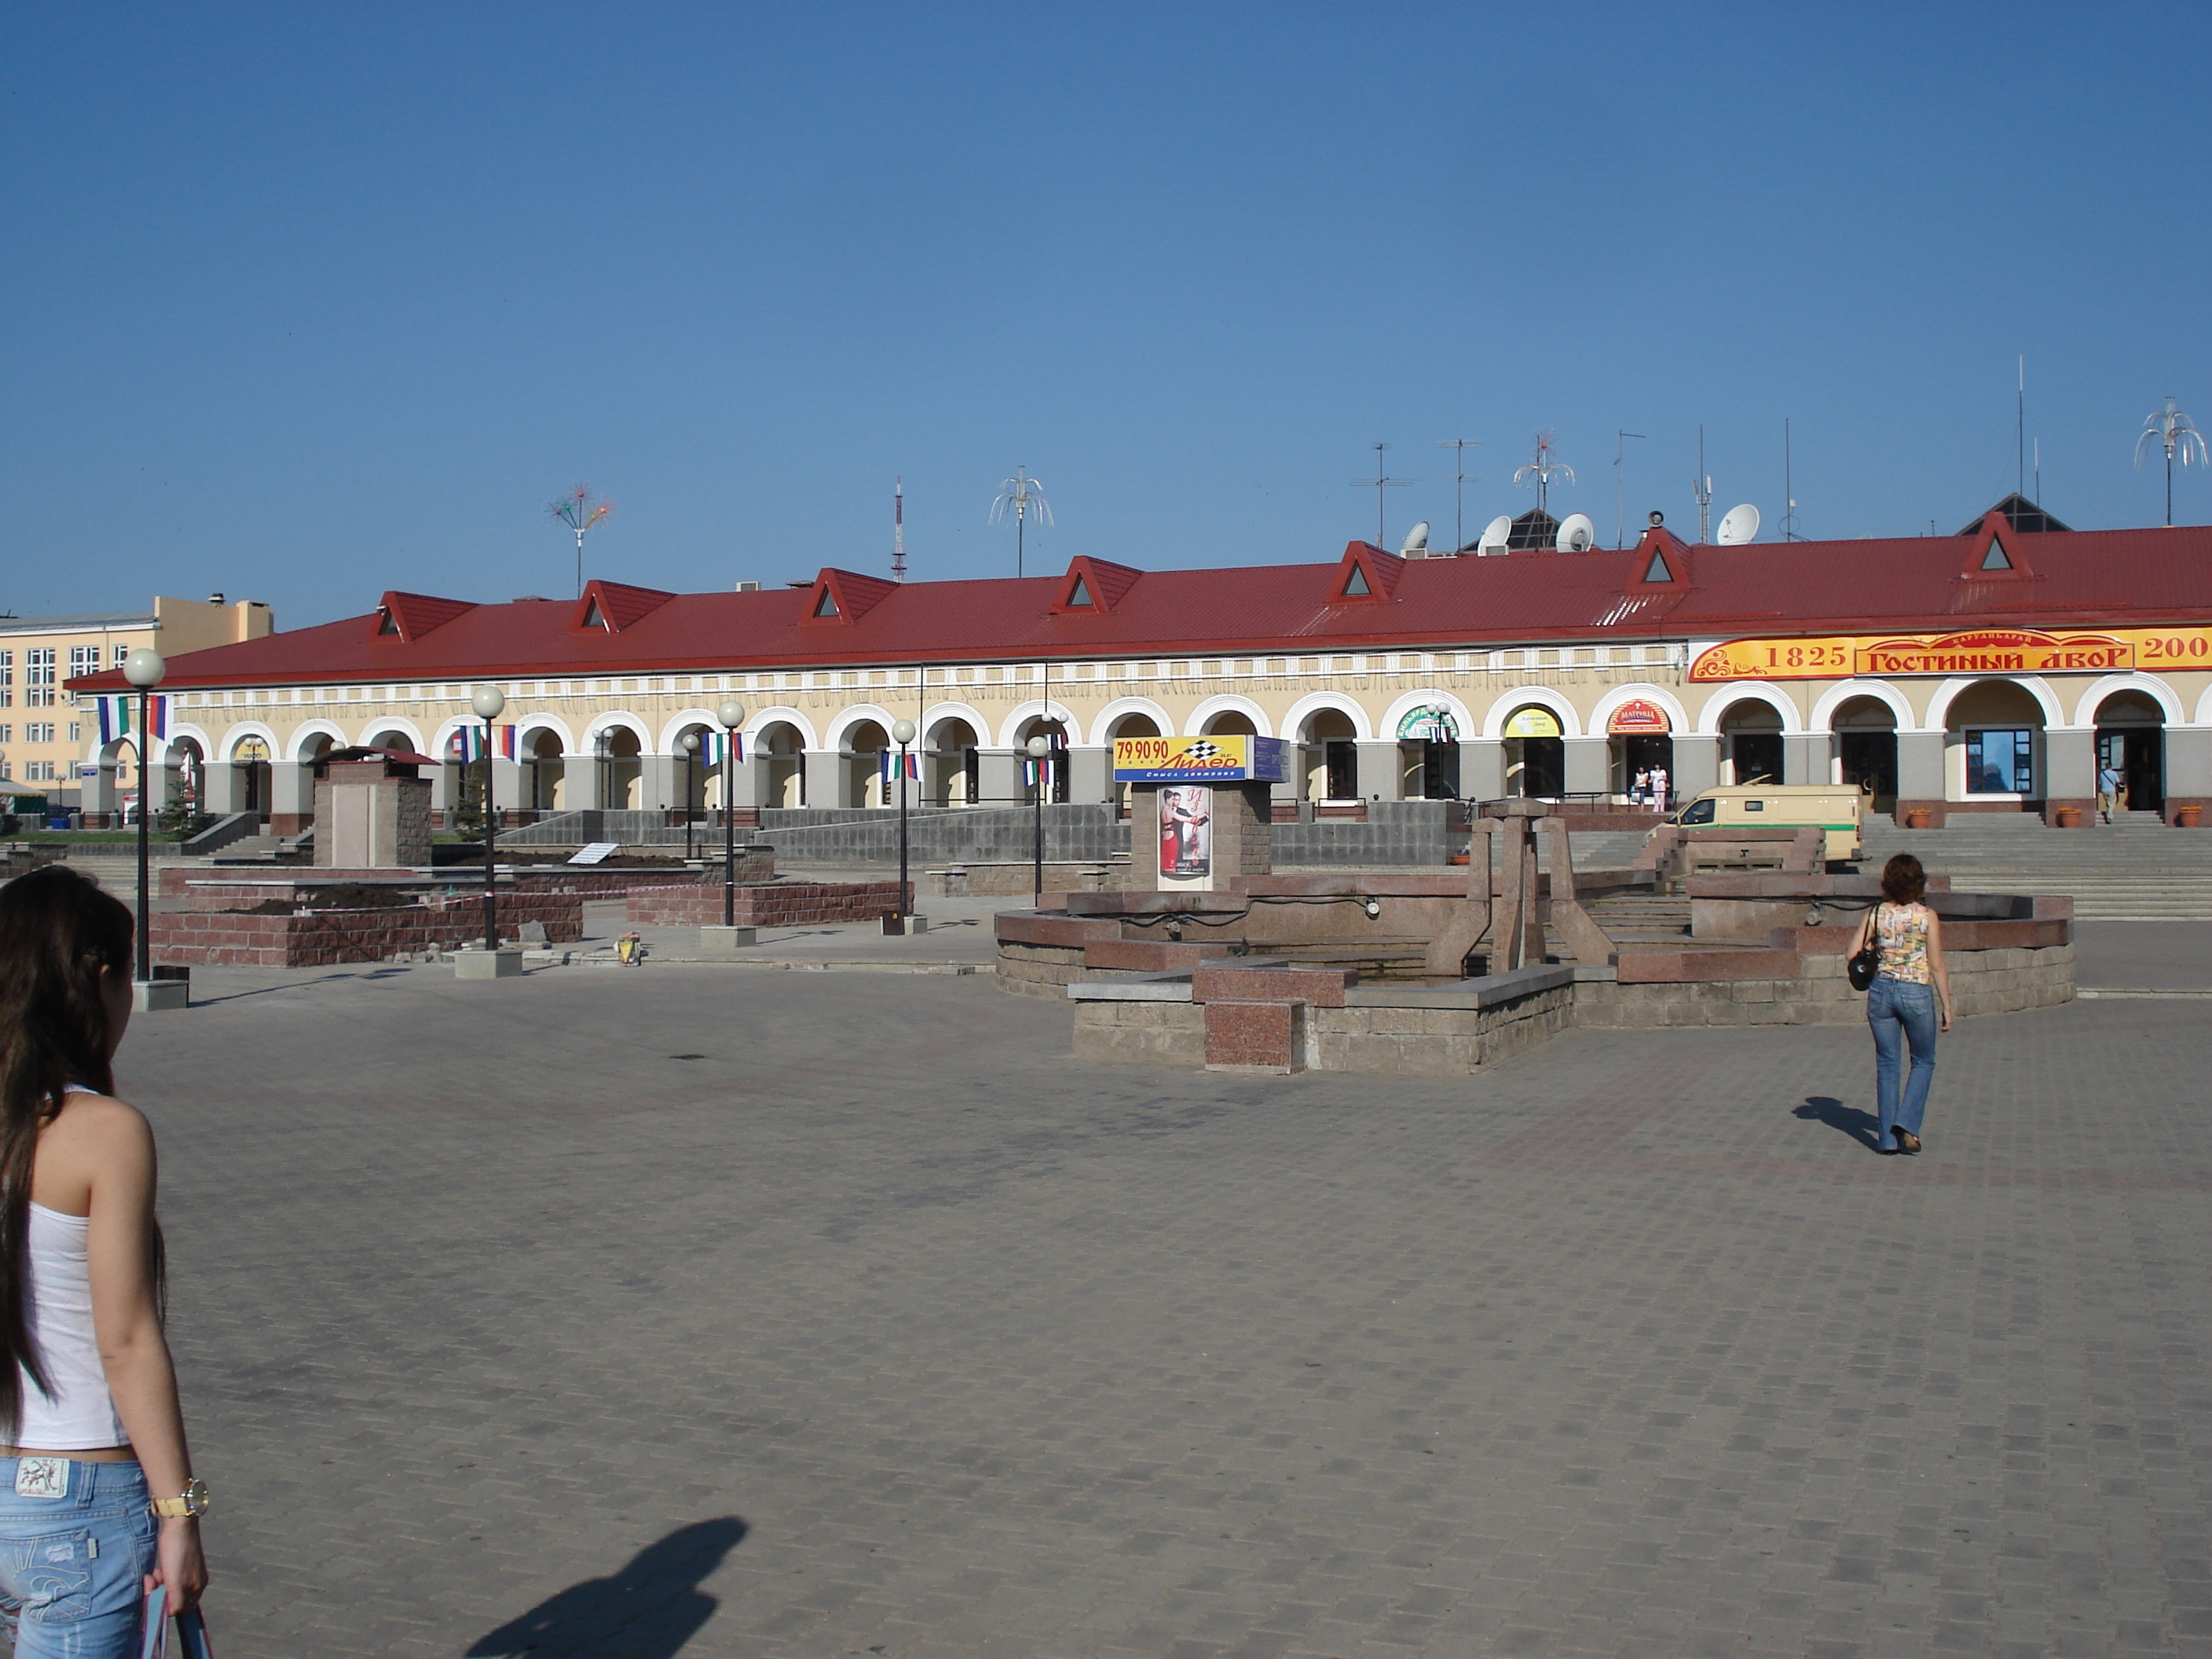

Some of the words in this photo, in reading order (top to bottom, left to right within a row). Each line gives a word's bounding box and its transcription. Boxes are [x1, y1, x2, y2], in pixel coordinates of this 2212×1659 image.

[1765, 646, 1846, 668] 1825
[2144, 637, 2212, 658] 200
[1117, 742, 1133, 760] 79
[1135, 741, 1151, 760] 90
[1152, 740, 1169, 759] 90
[1158, 753, 1238, 771] Лидер
